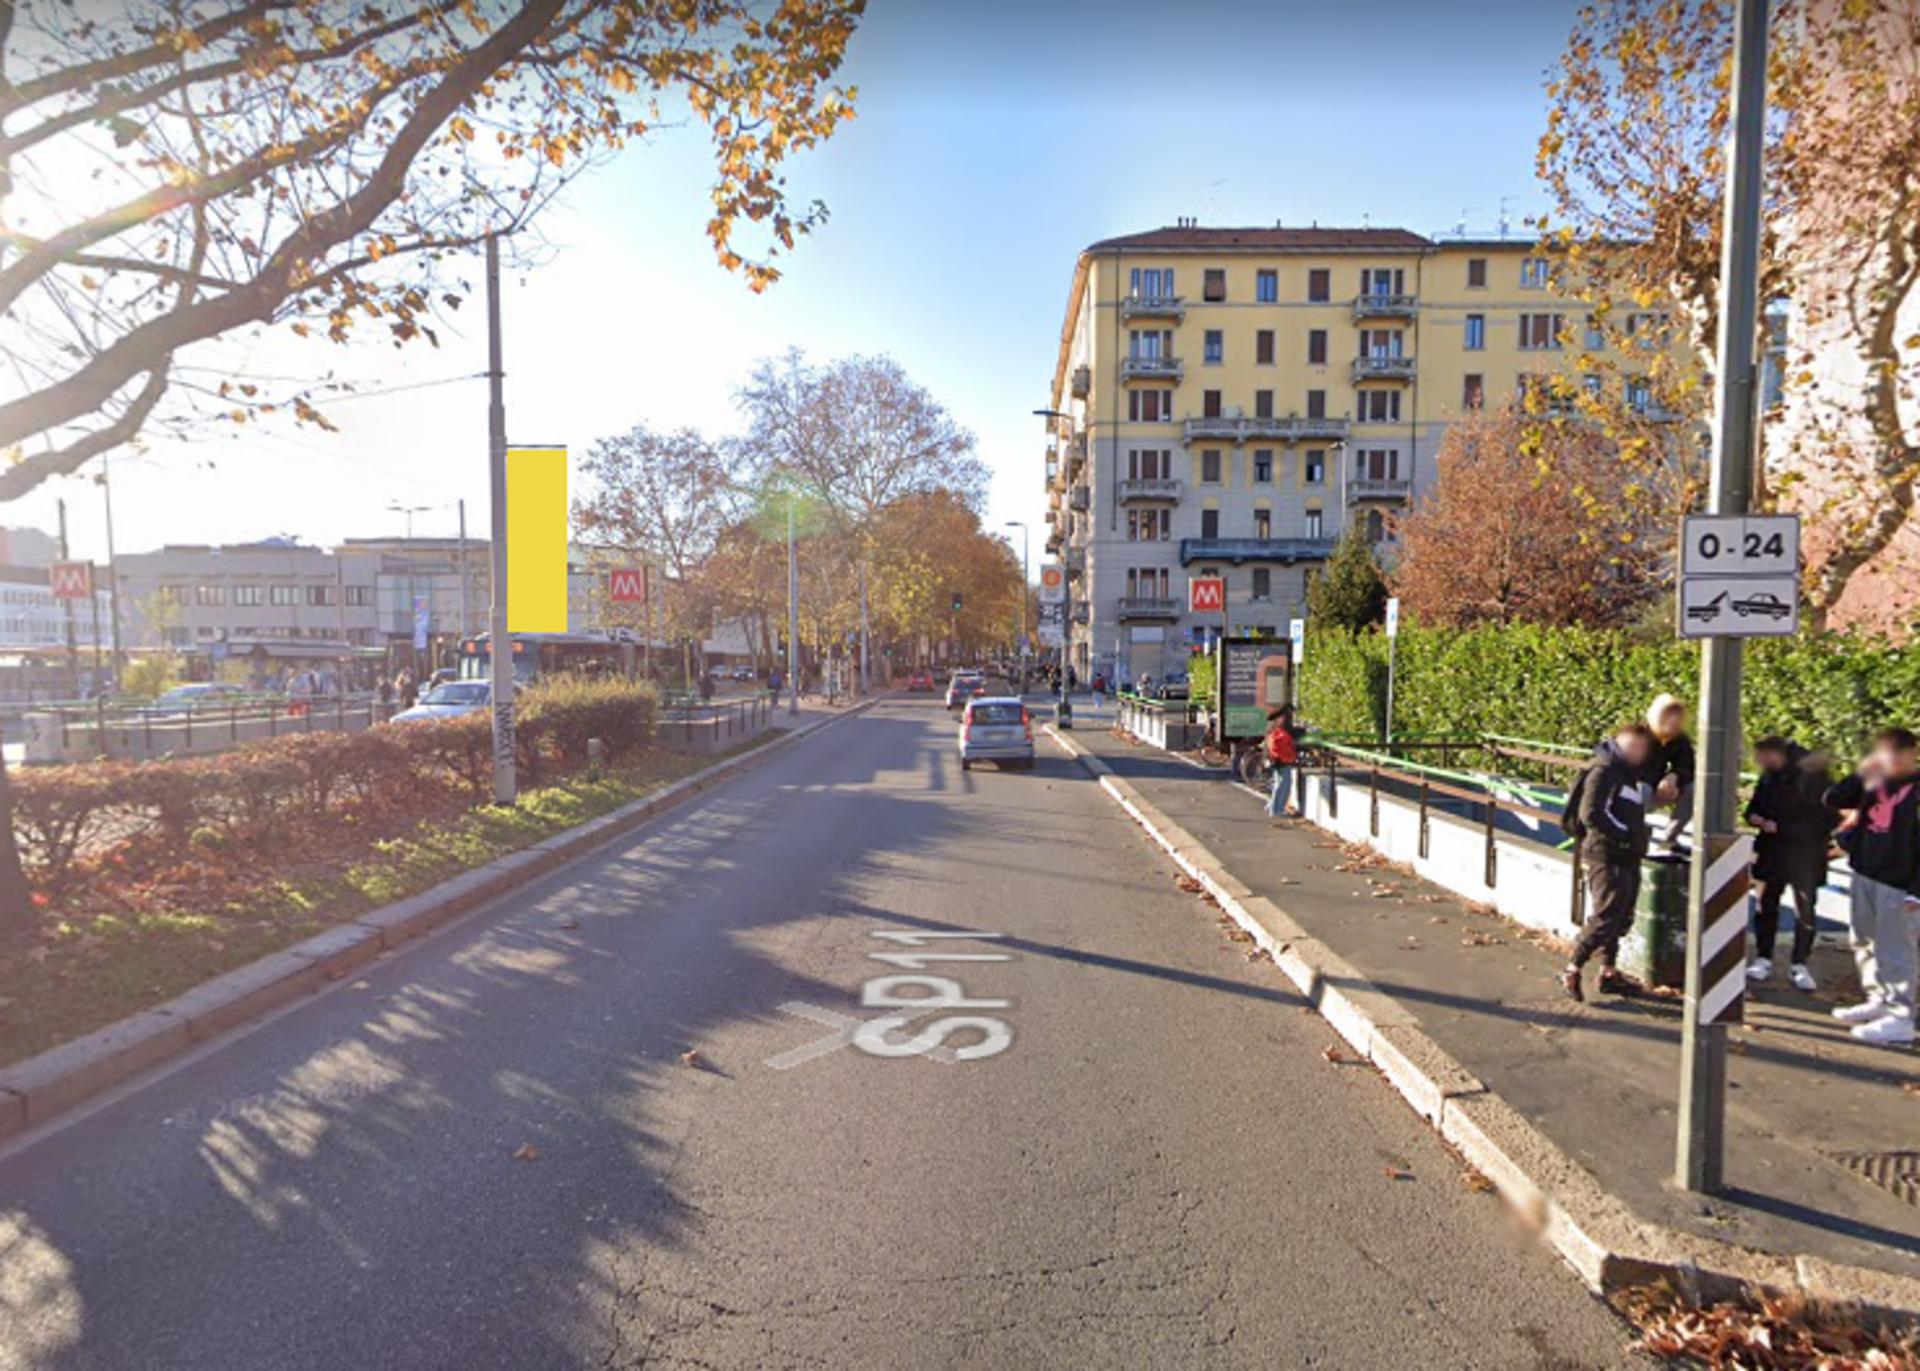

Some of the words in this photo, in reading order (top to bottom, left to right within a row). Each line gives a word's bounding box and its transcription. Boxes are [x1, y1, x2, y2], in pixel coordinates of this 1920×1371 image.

[1699, 533, 1720, 559] 0
[1744, 532, 1784, 558] 24
[613, 574, 640, 596] M
[1194, 584, 1219, 604] M
